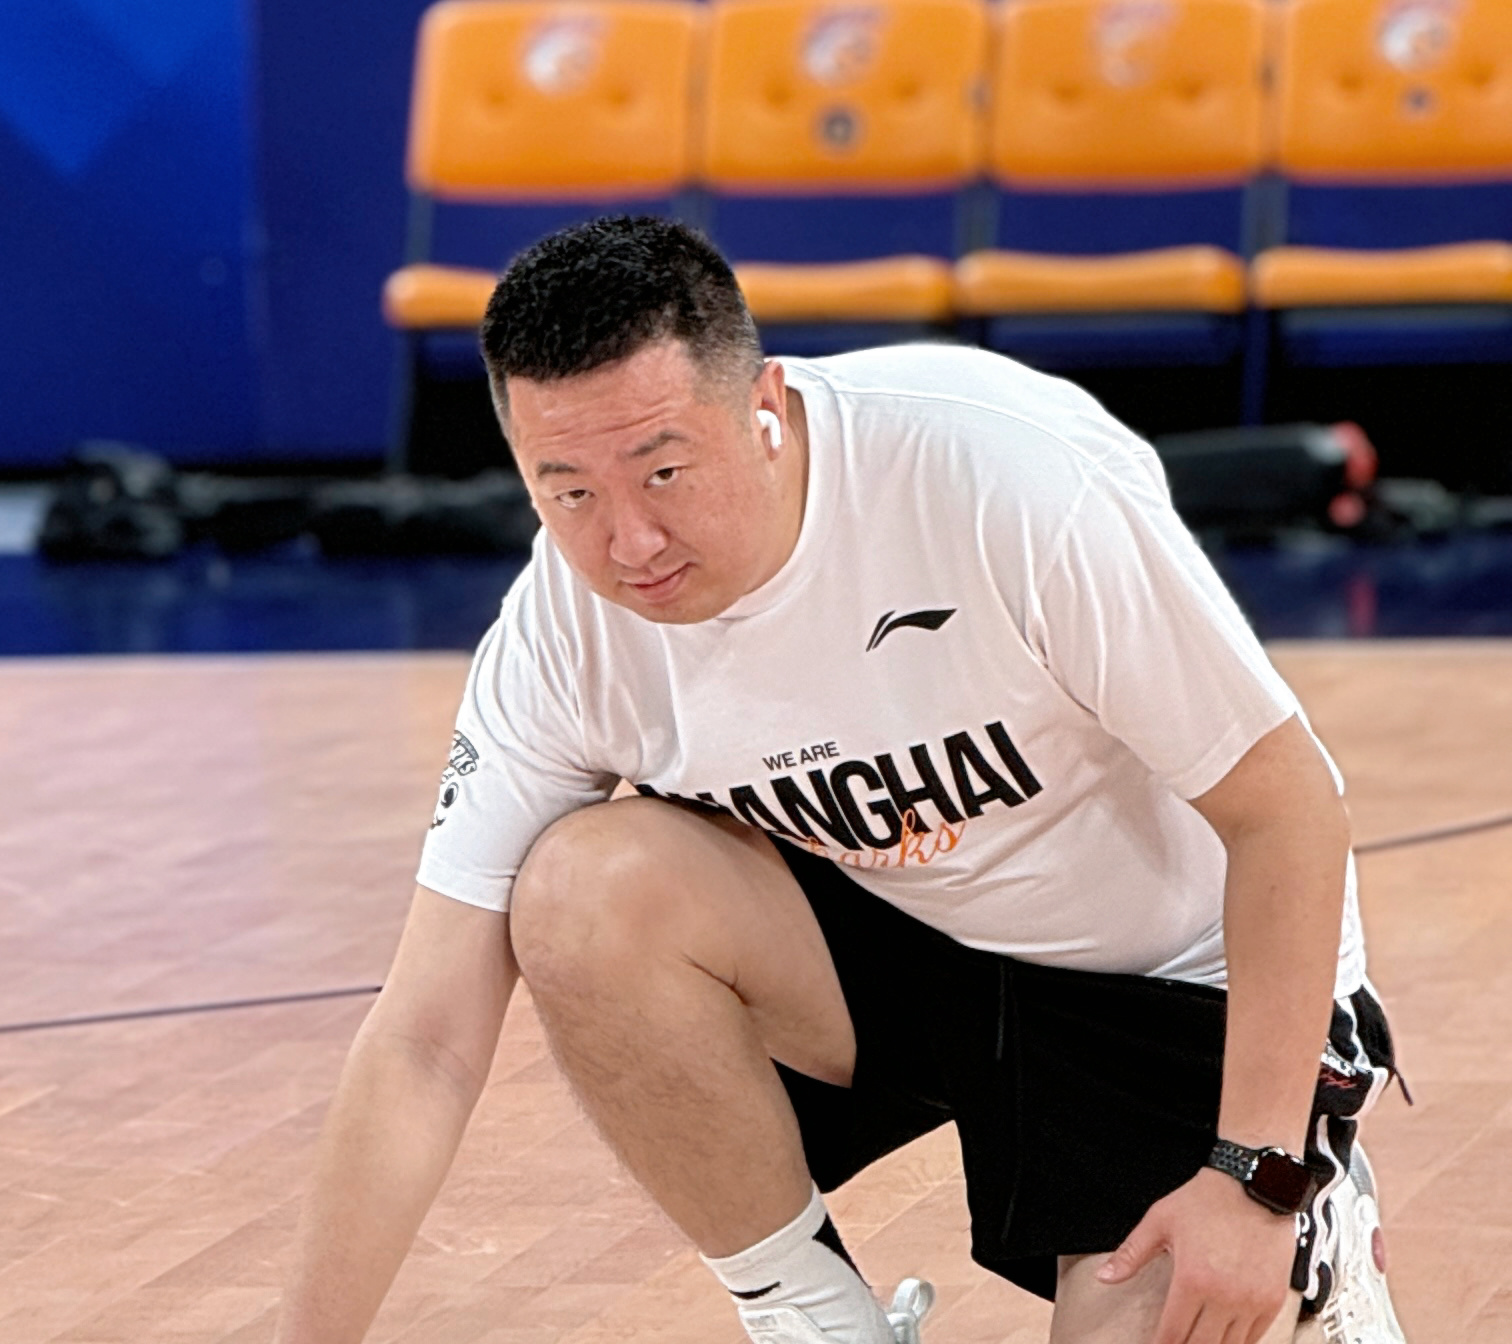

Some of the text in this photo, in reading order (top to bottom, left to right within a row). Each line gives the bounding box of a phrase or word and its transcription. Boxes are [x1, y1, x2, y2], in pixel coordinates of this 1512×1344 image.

[636, 721, 1044, 851] ANGHAI
[762, 741, 840, 771] WE ARE
